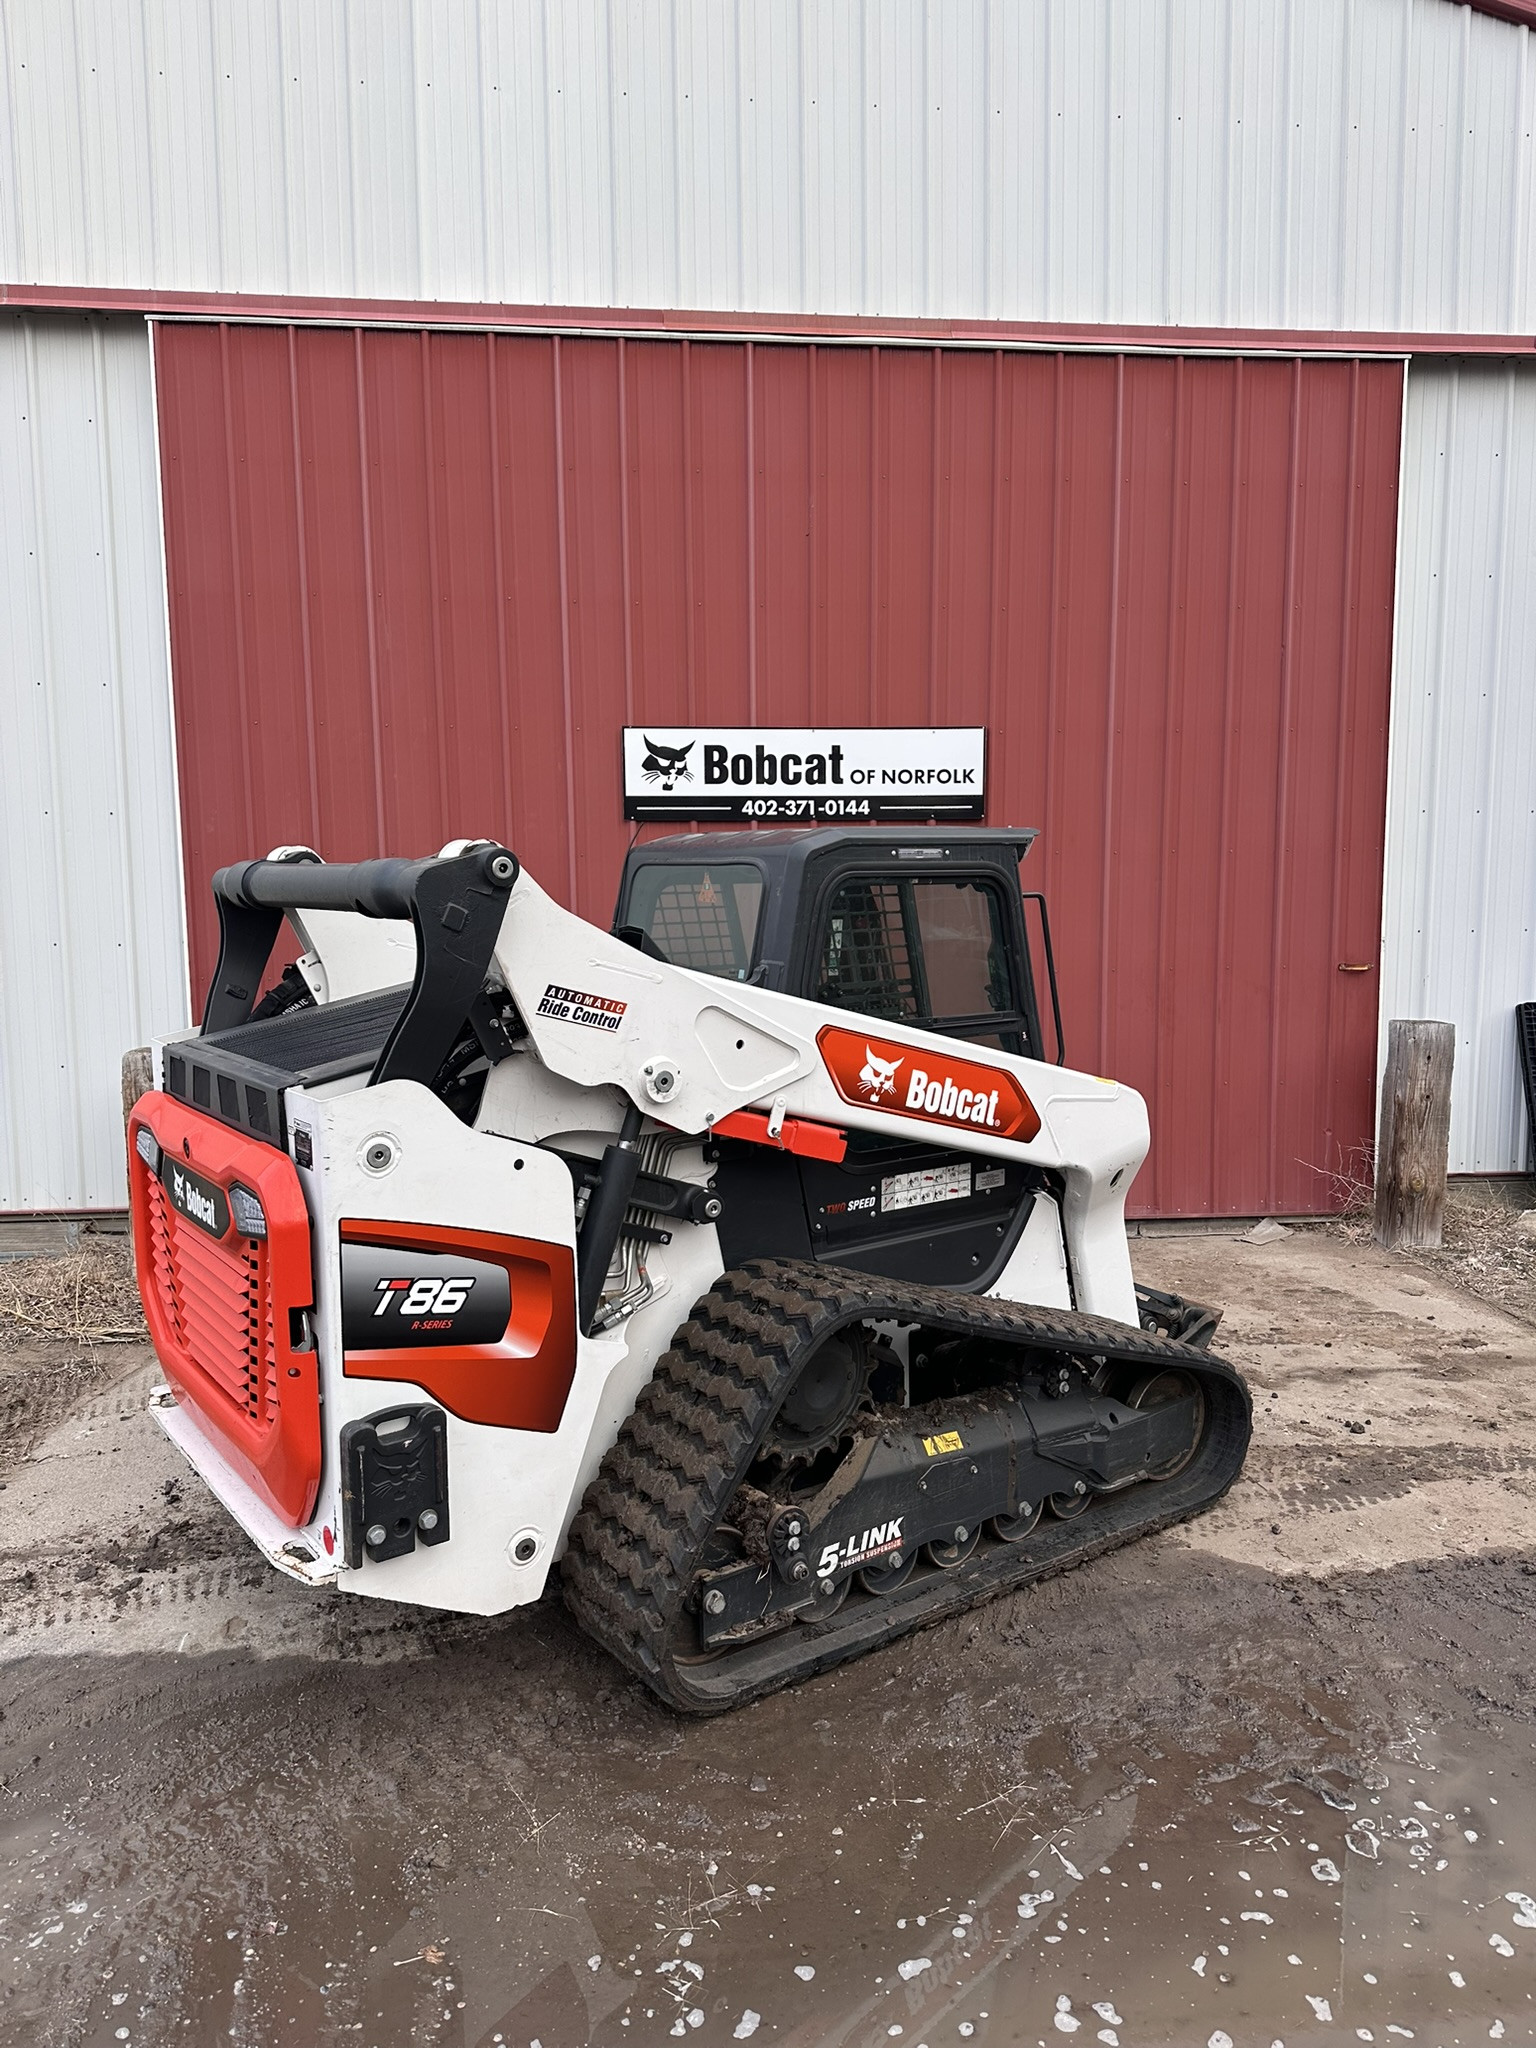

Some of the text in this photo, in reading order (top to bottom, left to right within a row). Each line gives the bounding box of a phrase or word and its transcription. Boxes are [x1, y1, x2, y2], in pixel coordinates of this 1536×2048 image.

[704, 745, 975, 786] Bobcat OF NORFOLK
[741, 800, 870, 815] 402-371-0144
[537, 998, 622, 1030] Ride Control
[548, 987, 624, 1013] AUTOMATIC
[905, 1069, 999, 1126] Bobcat
[186, 1181, 217, 1229] Bobcat
[827, 1196, 876, 1214] TWO SPEED
[372, 1277, 476, 1316] T86
[411, 1320, 453, 1330] R-SERIES
[816, 1516, 904, 1578] 5-LINK
[840, 1554, 865, 1569] TORSION
